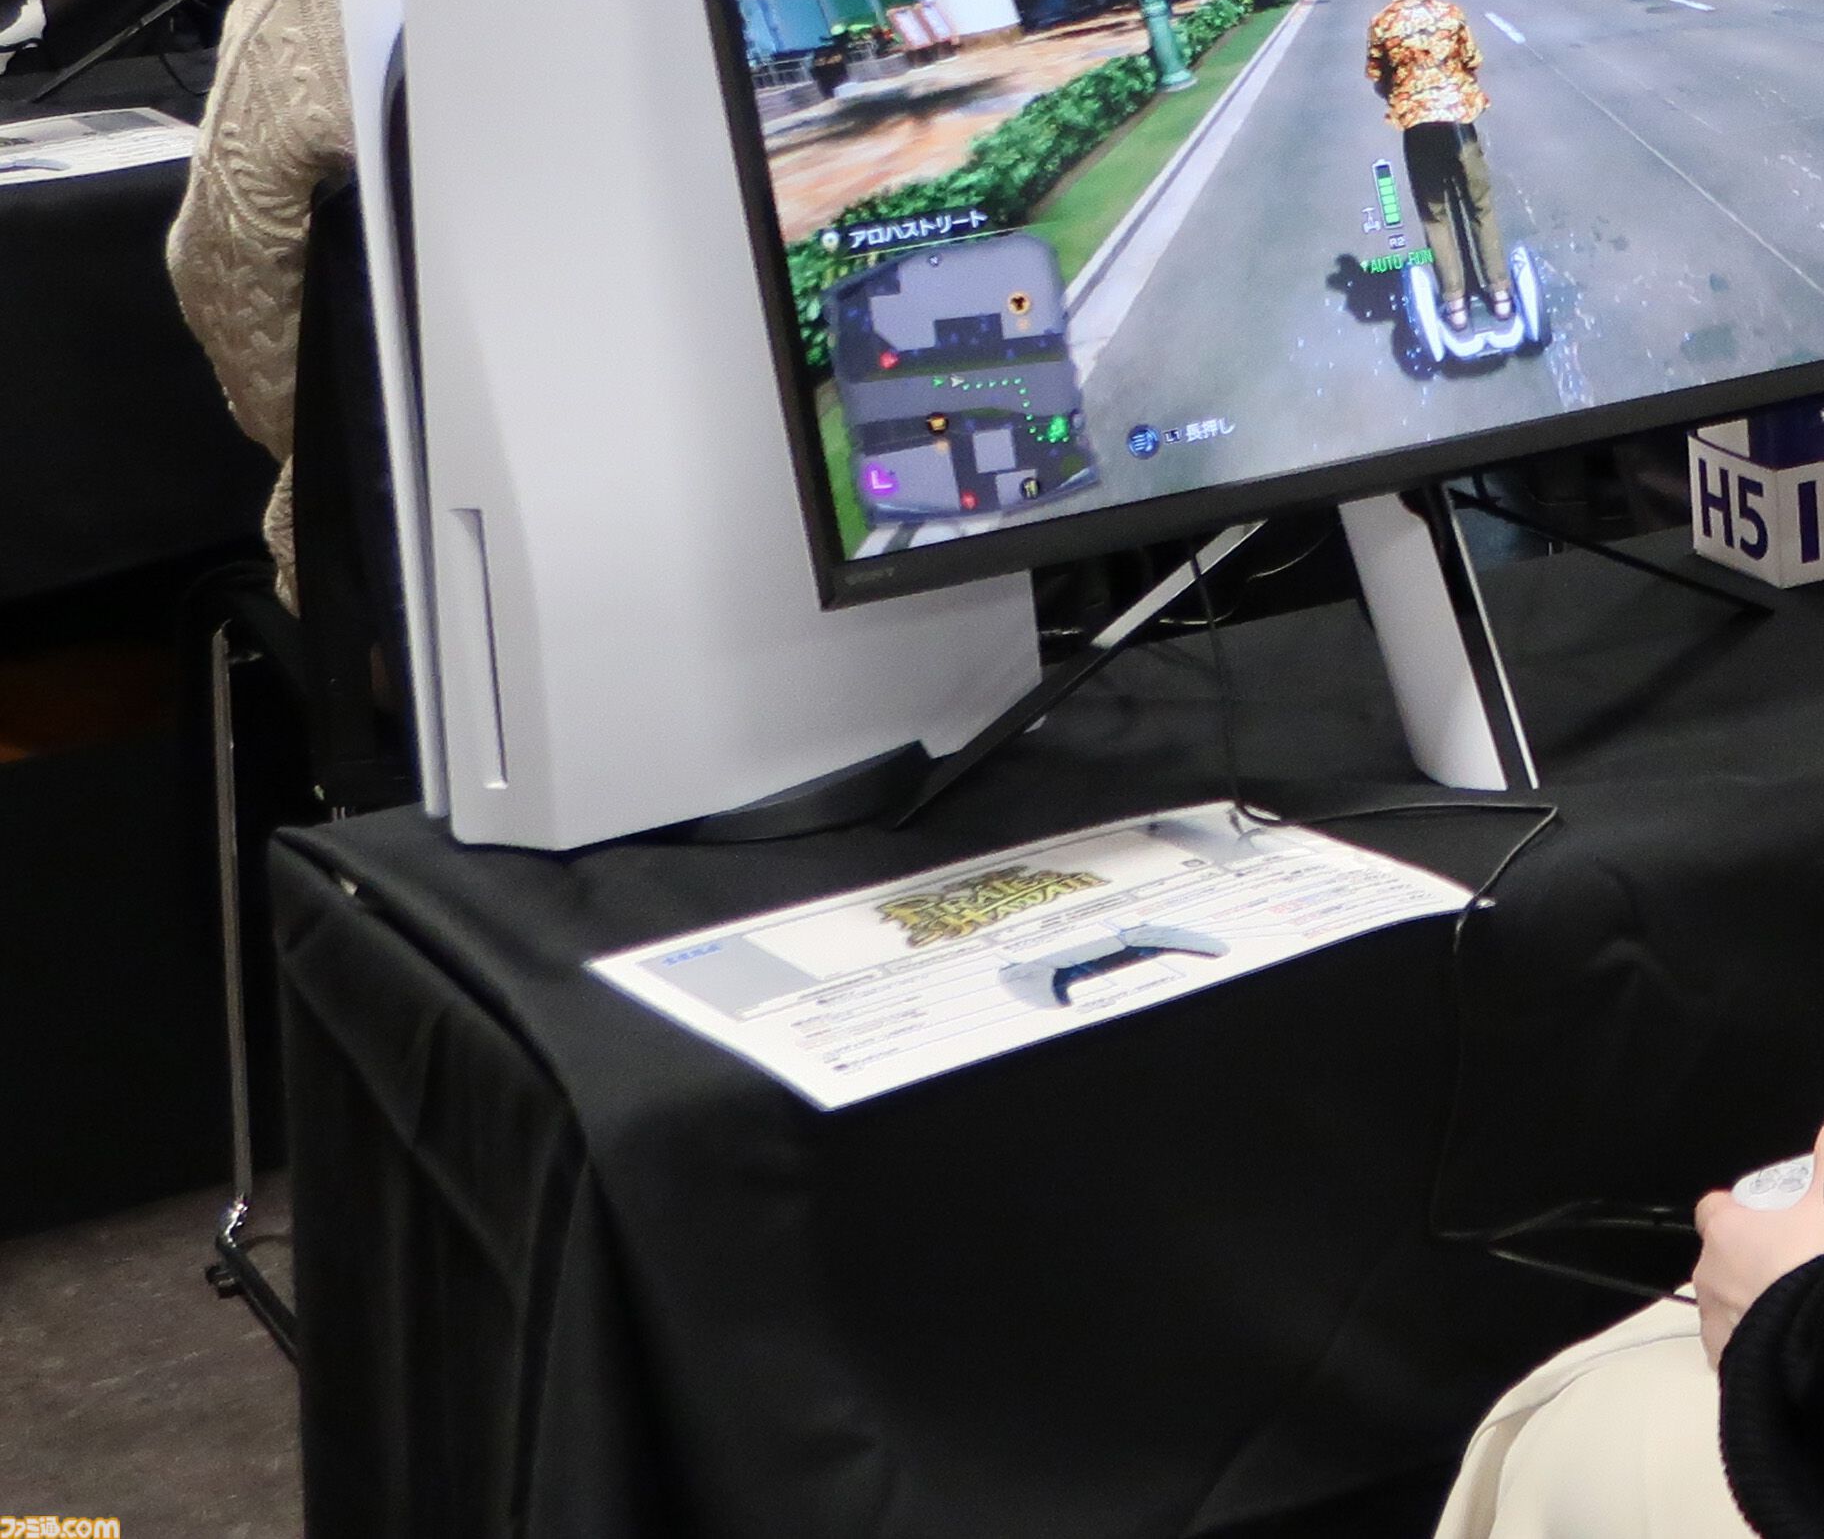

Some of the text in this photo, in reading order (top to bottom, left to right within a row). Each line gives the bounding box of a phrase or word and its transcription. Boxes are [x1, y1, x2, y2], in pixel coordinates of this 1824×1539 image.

[849, 209, 989, 249] アロハストリート
[1388, 236, 1406, 248] R2
[1371, 254, 1402, 274] AUTO
[1185, 417, 1236, 443] 長押し
[1697, 456, 1769, 562] H5
